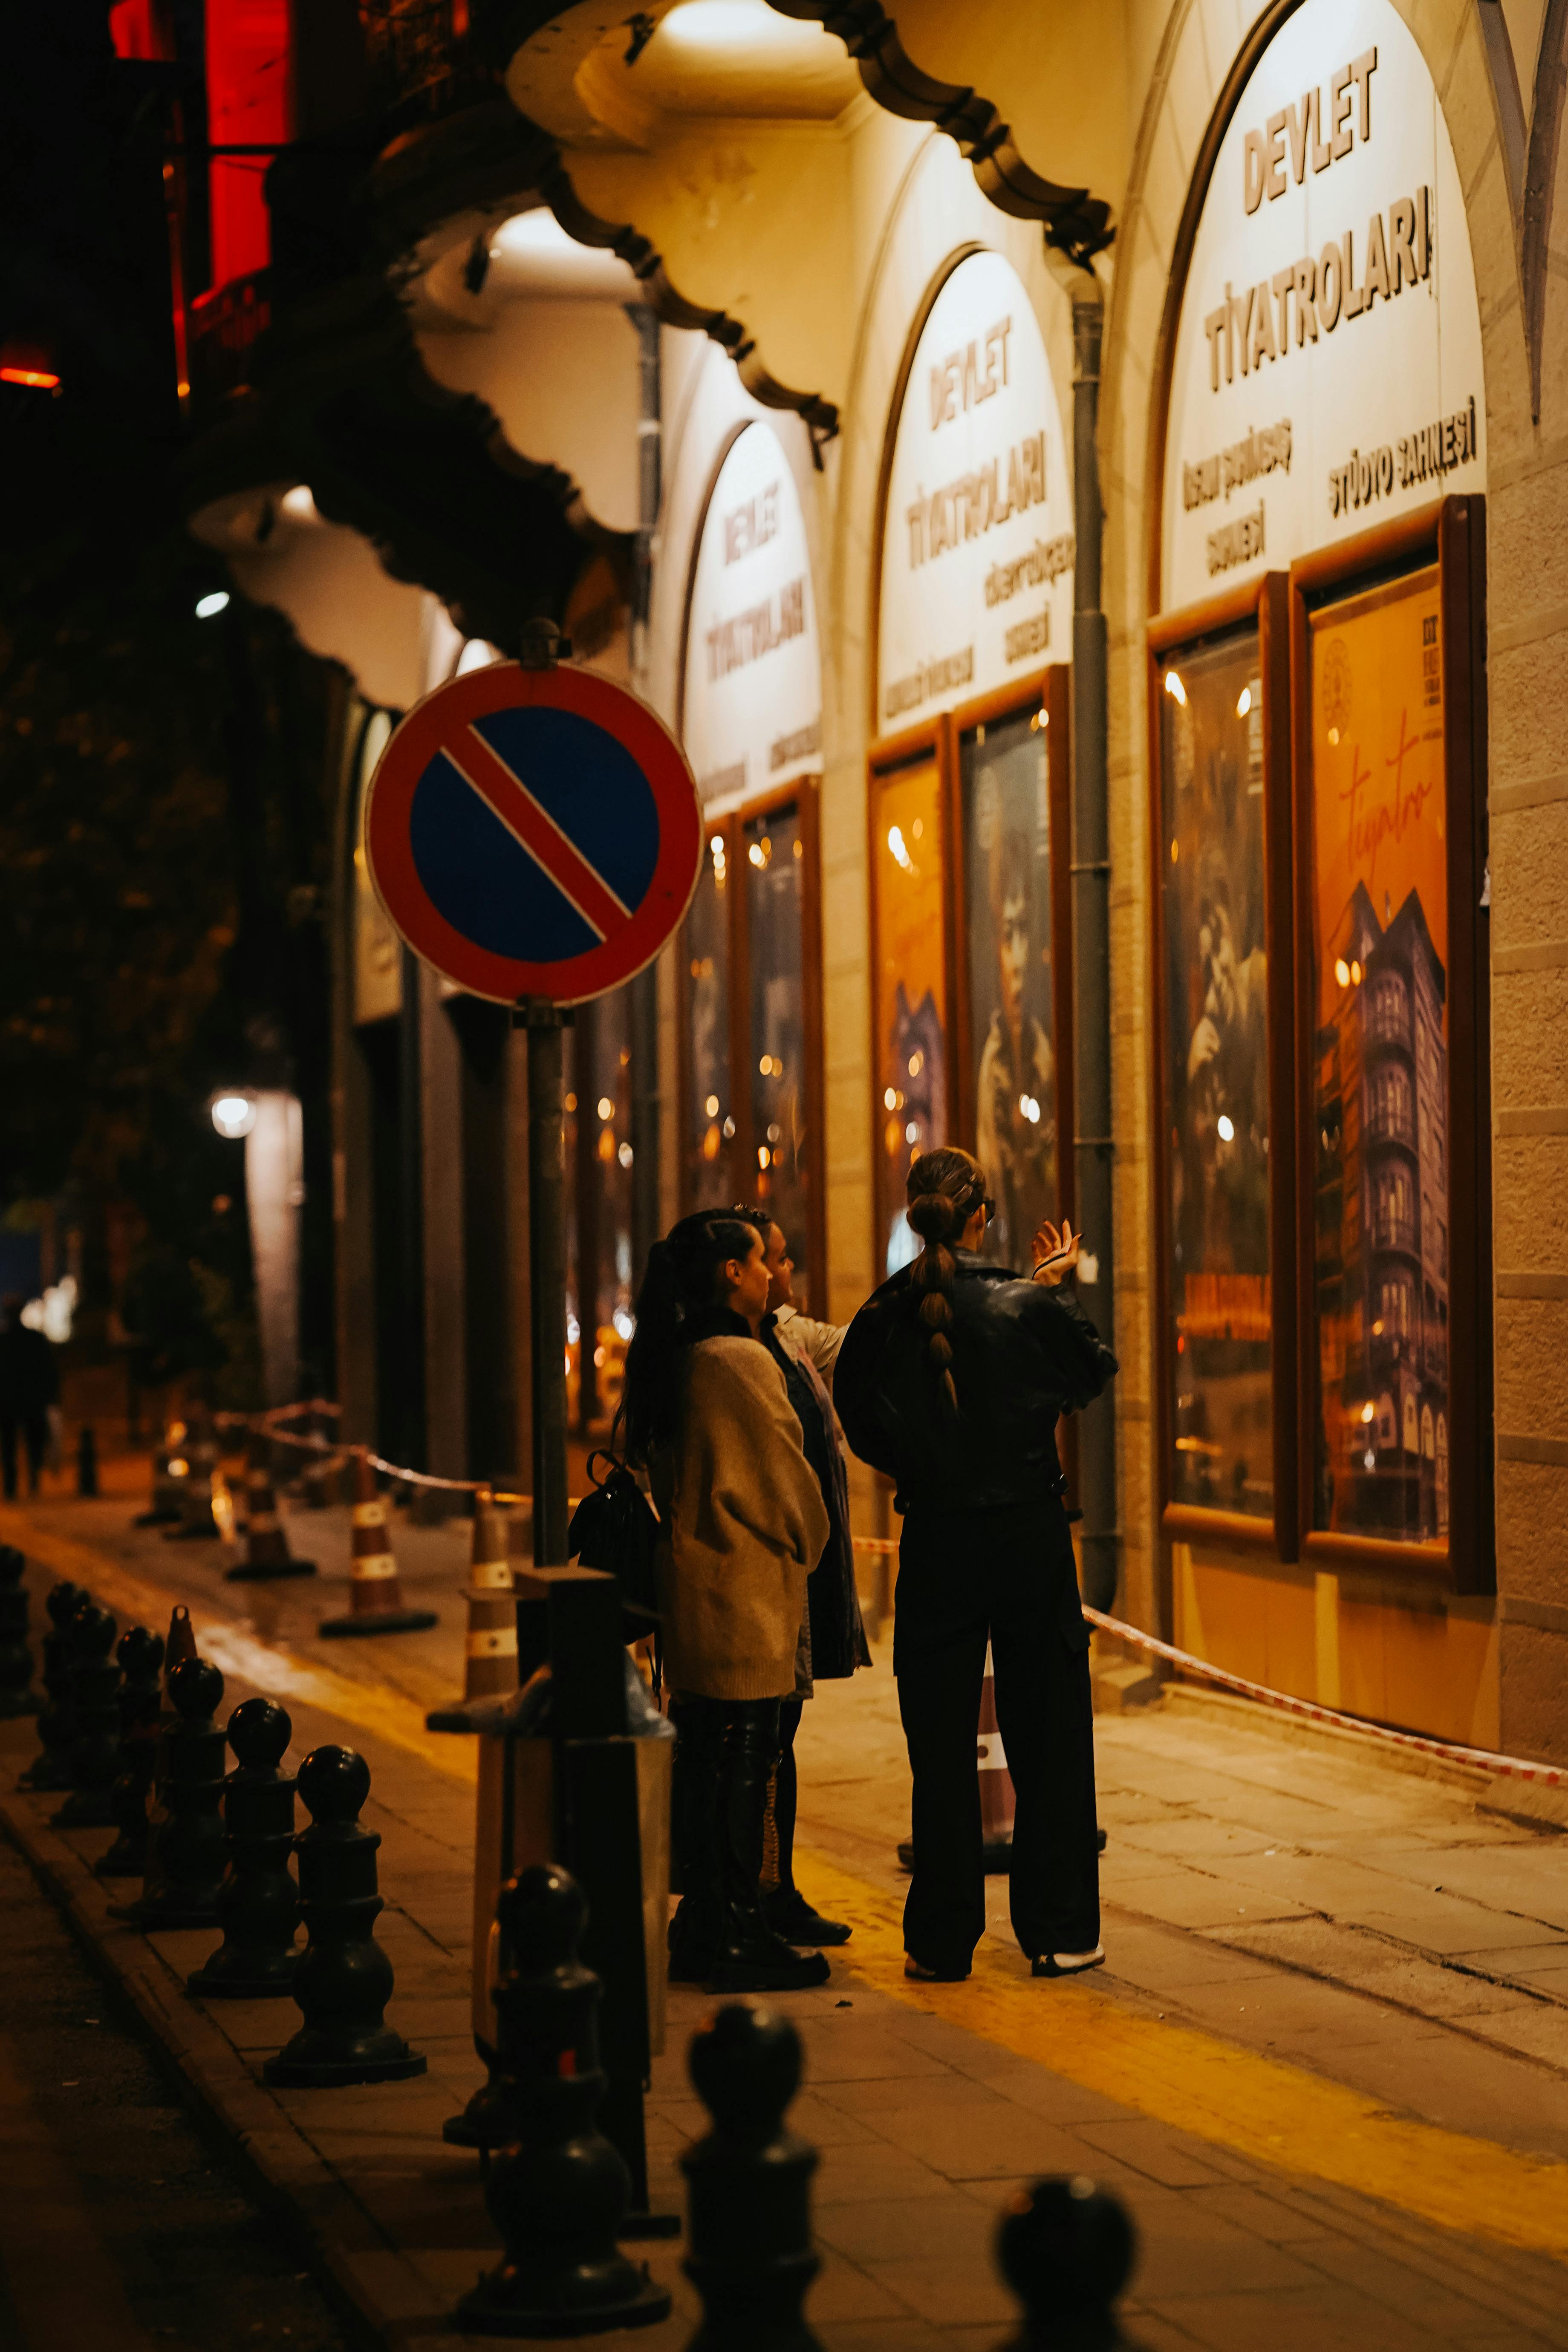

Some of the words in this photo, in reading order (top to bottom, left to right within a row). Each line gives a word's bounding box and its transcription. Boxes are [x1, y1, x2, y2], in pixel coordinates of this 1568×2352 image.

[1243, 45, 1378, 216] DEVLET
[1204, 185, 1432, 392] TİYATROLARI
[929, 315, 1012, 431] DEVLET
[1328, 445, 1393, 519] STÜDYO
[1397, 395, 1476, 489] SAHNESİ
